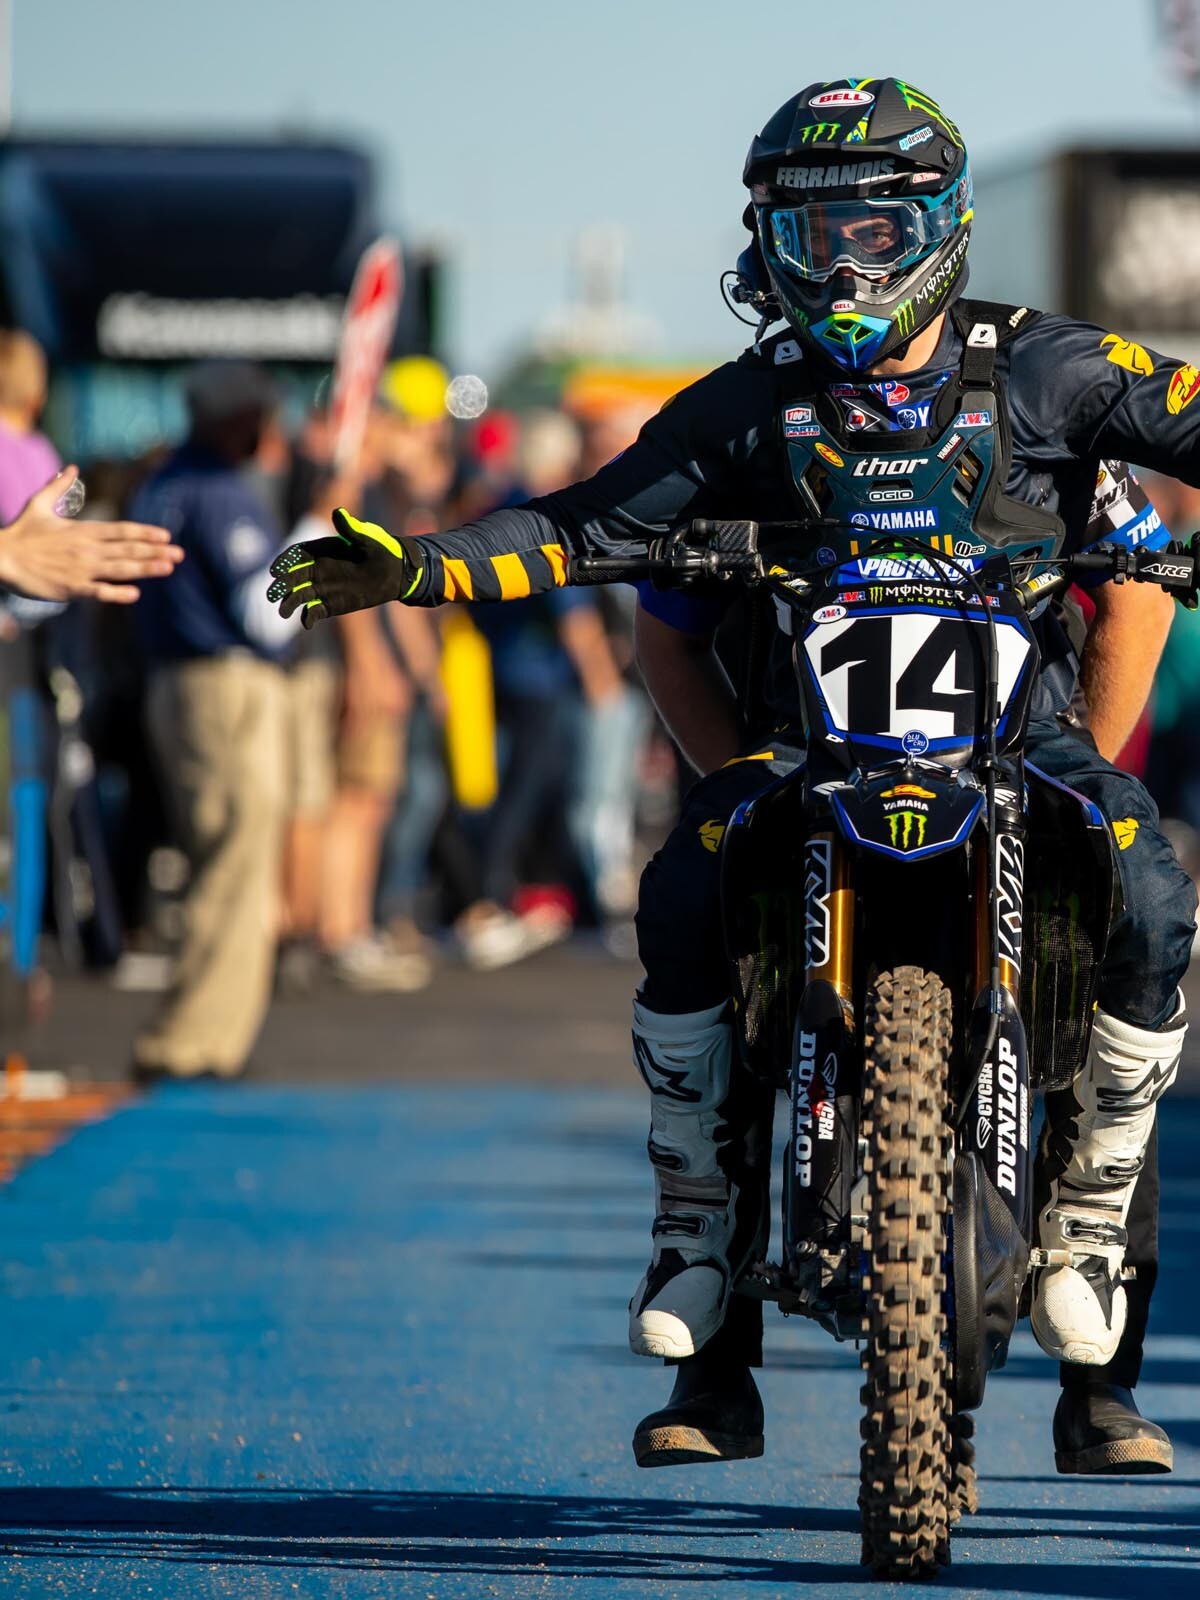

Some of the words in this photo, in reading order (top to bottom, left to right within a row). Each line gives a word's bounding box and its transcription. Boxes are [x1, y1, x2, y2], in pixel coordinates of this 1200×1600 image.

[819, 92, 864, 103] BELL
[776, 158, 896, 188] FERRANDIS
[916, 232, 969, 304] MONSTER
[788, 410, 809, 420] 100%
[954, 412, 991, 428] AMA
[853, 458, 928, 477] thor
[870, 490, 913, 500] OGIO
[871, 510, 936, 530] YAMAHA
[1127, 508, 1161, 545] THO
[1140, 563, 1192, 578] ARC
[832, 591, 867, 604] AMA
[885, 584, 966, 601] MONSTER
[897, 597, 954, 606] ENERGY
[819, 608, 841, 619] AMA
[821, 616, 1001, 736] 14
[883, 800, 929, 811] YAMAHA
[977, 1062, 993, 1117] CYCRA
[795, 1030, 817, 1188] DUNLOP
[997, 1037, 1018, 1197] DUNLOP
